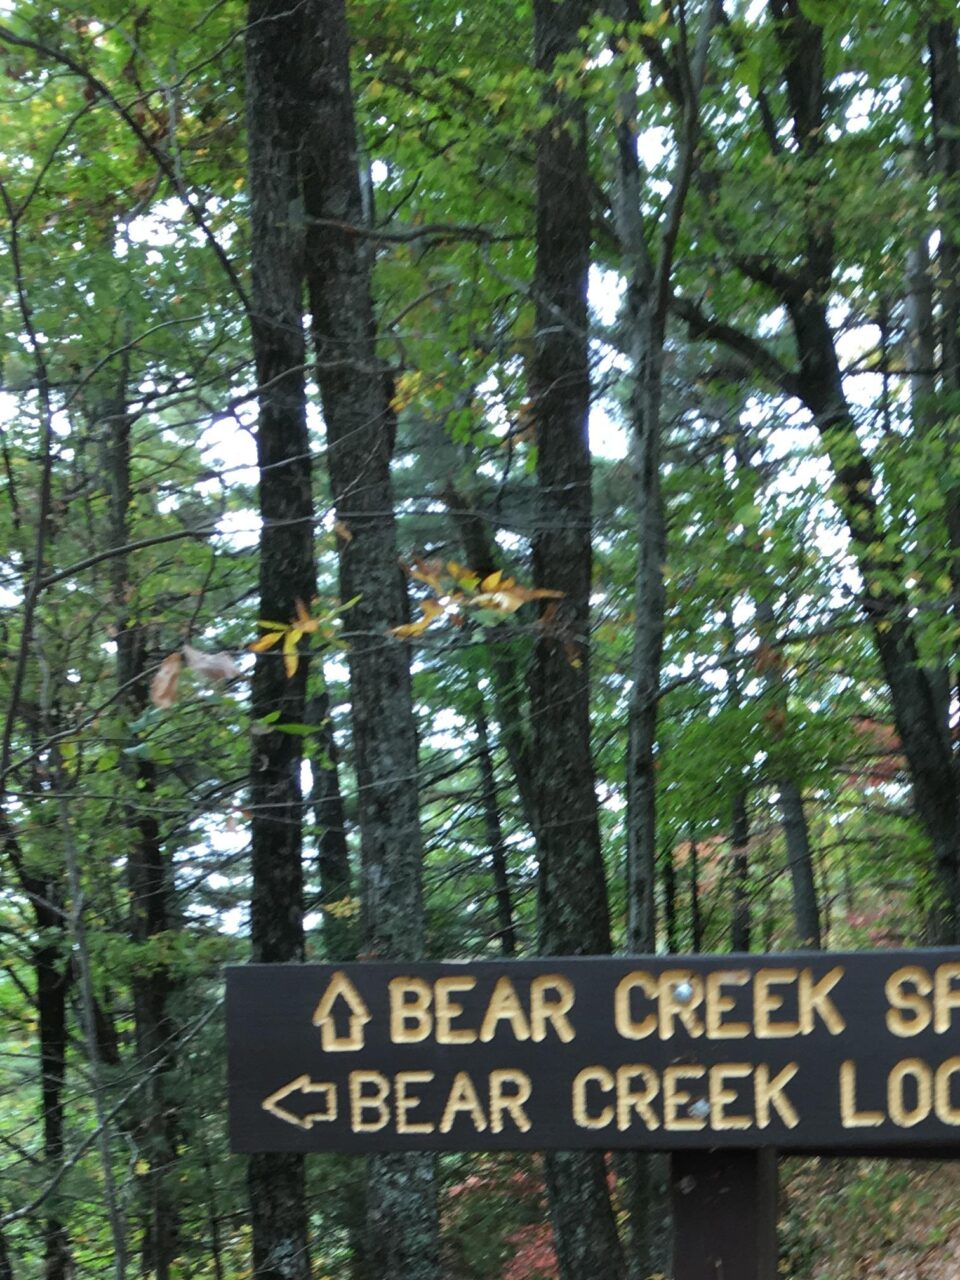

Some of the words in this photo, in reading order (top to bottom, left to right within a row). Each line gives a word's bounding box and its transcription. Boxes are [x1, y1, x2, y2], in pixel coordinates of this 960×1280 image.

[388, 974, 576, 1043] BEAR
[614, 966, 845, 1039] CREEK
[348, 1068, 531, 1133] BEAR
[572, 1061, 797, 1130] CREEK
